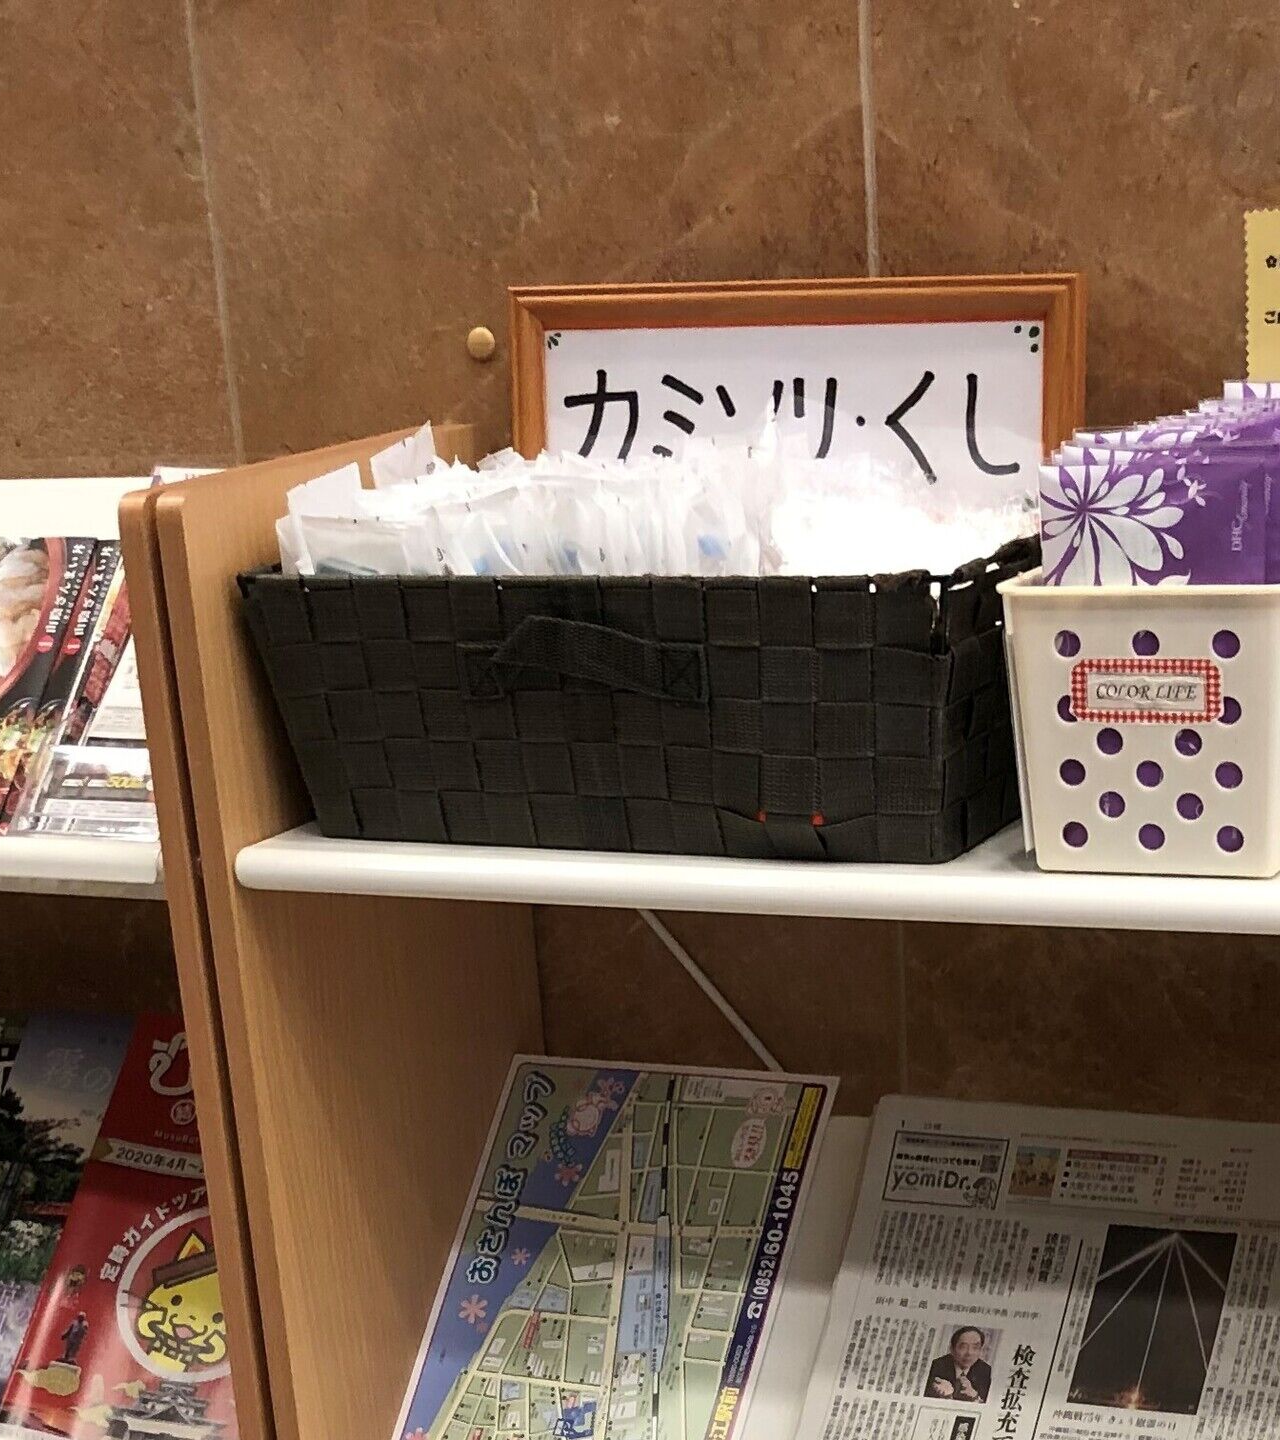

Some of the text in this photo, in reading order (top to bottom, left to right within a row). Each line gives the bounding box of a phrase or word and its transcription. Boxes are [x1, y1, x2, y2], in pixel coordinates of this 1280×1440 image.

[1155, 683, 1198, 700] LIFE
[465, 1071, 557, 1285] おさんぽ マップ
[891, 1168, 974, 1196] yomiDr.
[751, 1169, 800, 1301] (0852)60-1045
